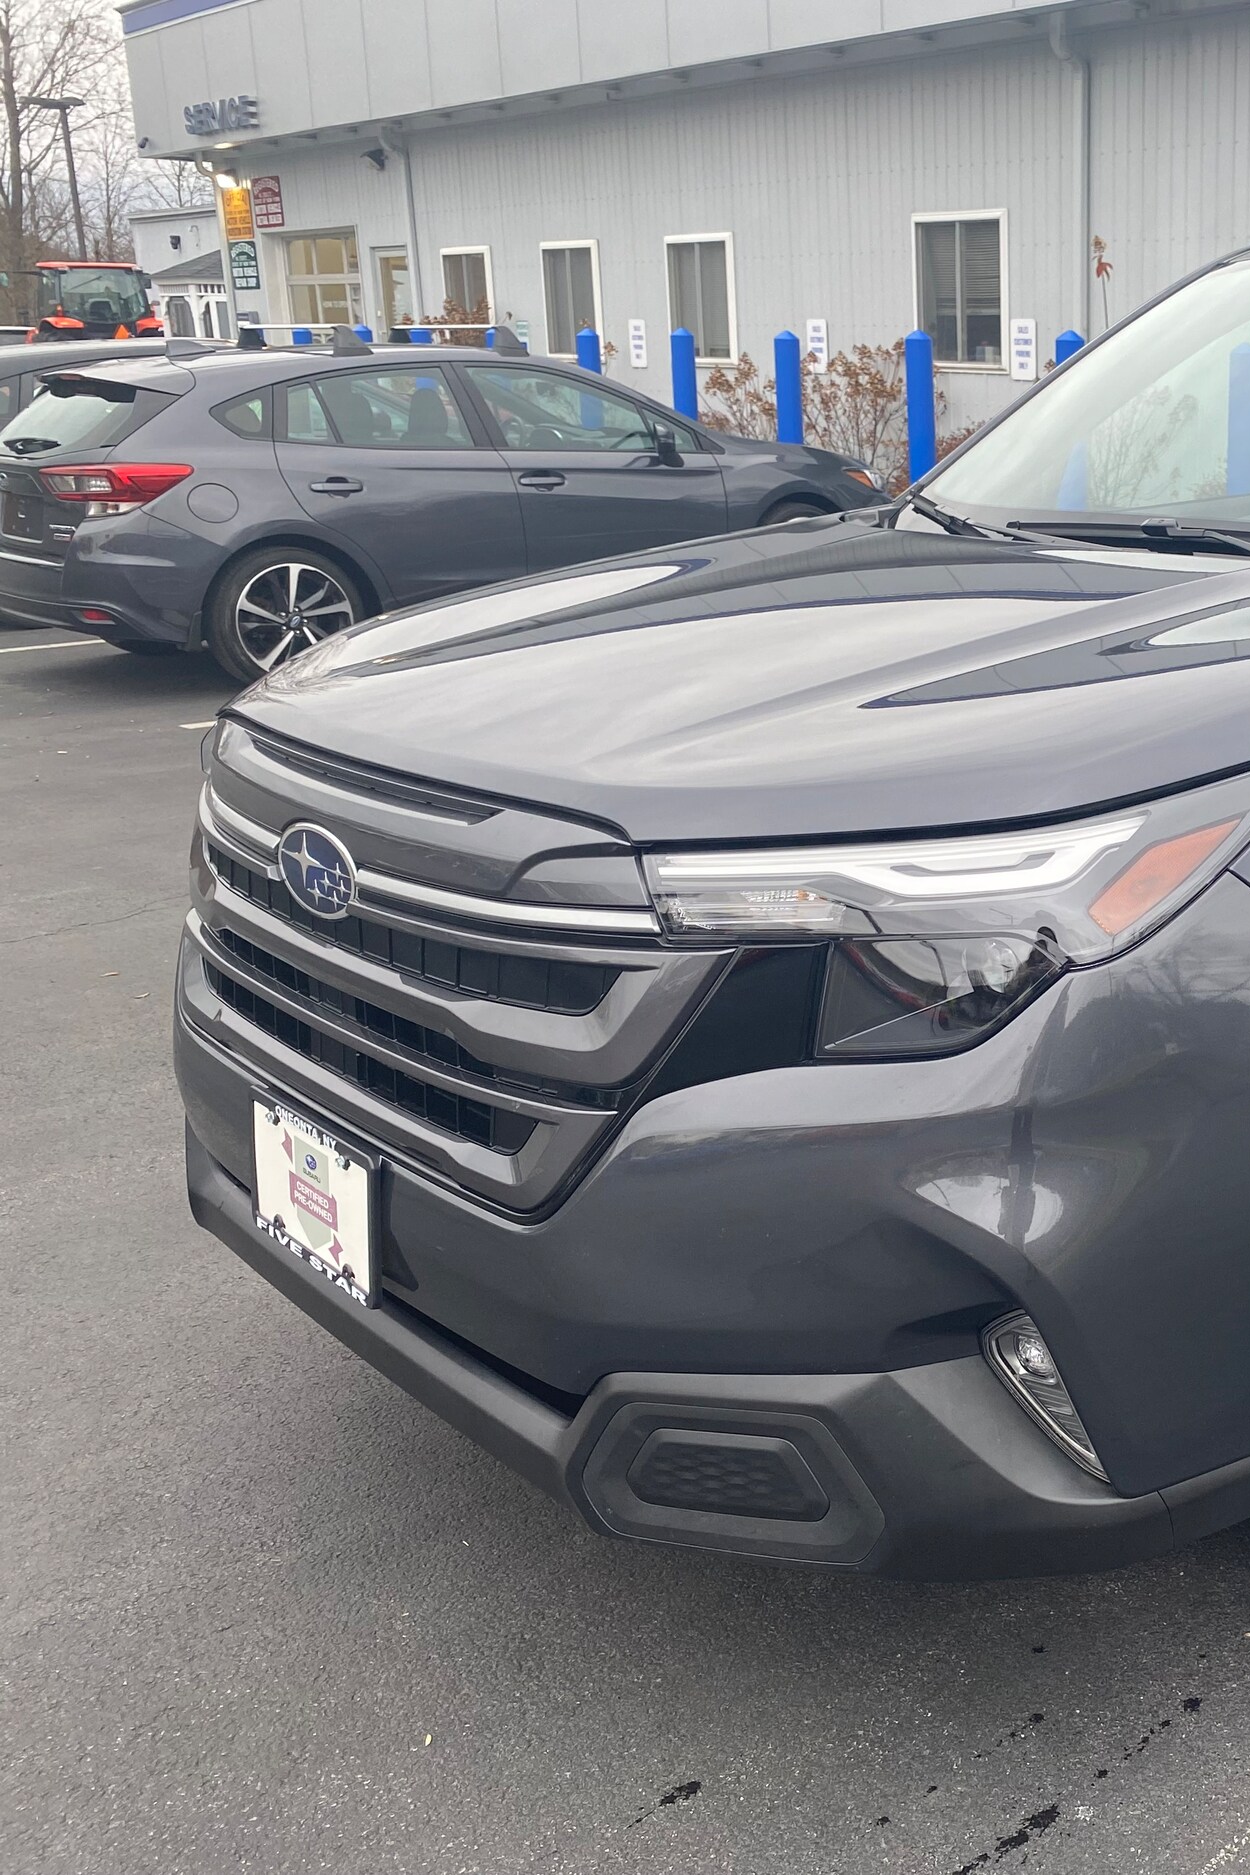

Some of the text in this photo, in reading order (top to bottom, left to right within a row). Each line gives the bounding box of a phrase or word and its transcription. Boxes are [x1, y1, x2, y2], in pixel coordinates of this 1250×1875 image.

[184, 95, 259, 135] SERVICE
[275, 1105, 337, 1151] ONEONTA, NY
[294, 1189, 333, 1223] PRE-OWNED
[296, 1180, 329, 1209] CERTIFIED
[256, 1216, 304, 1259] FIVE
[309, 1254, 367, 1307] STAR
